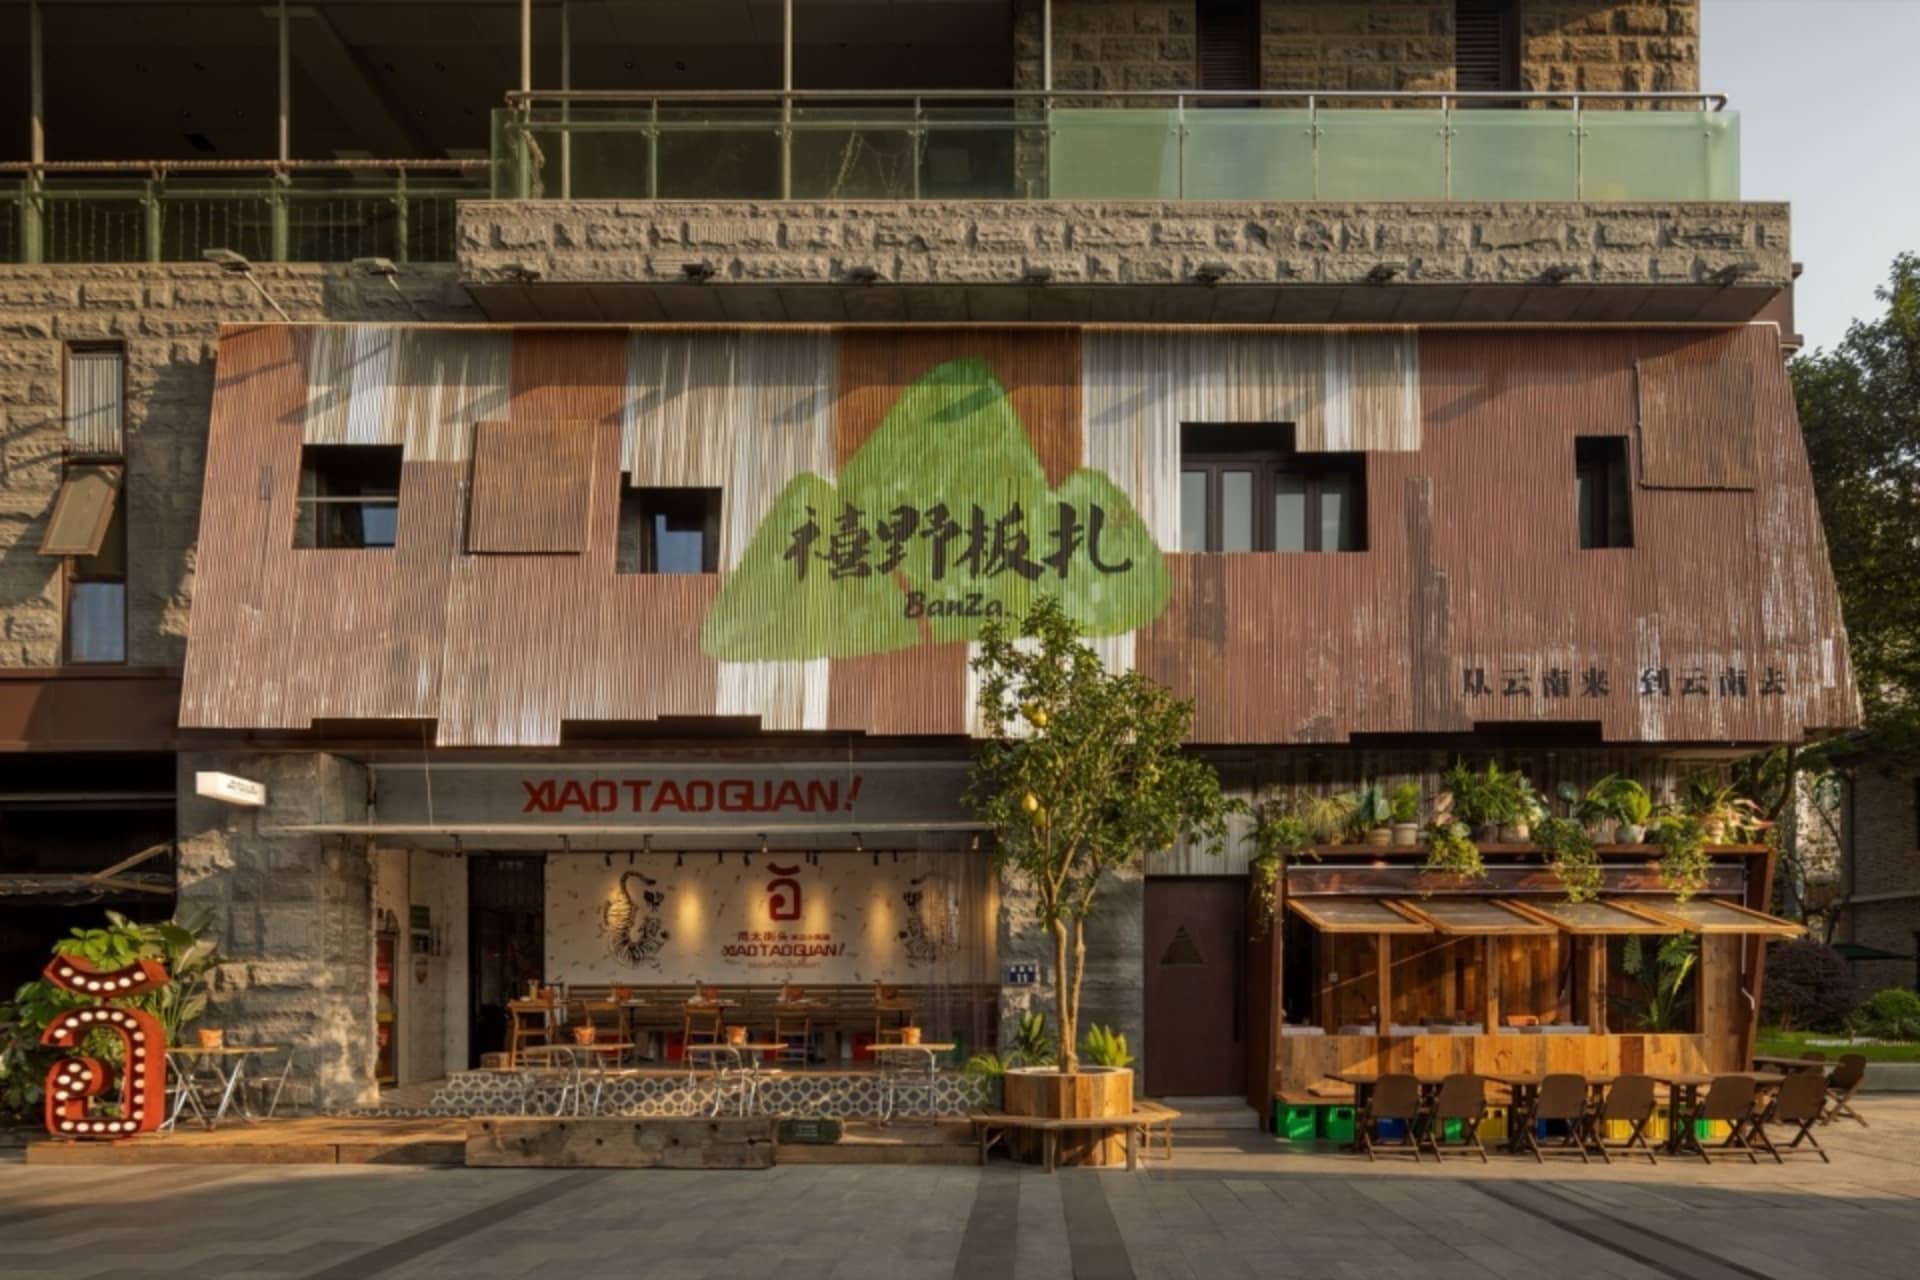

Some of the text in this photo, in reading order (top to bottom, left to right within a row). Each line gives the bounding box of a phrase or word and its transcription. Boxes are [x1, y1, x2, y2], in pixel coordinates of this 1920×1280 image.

[783, 502, 1133, 580] 禧野板扎
[1463, 667, 1787, 698] 从云南来 到云南去
